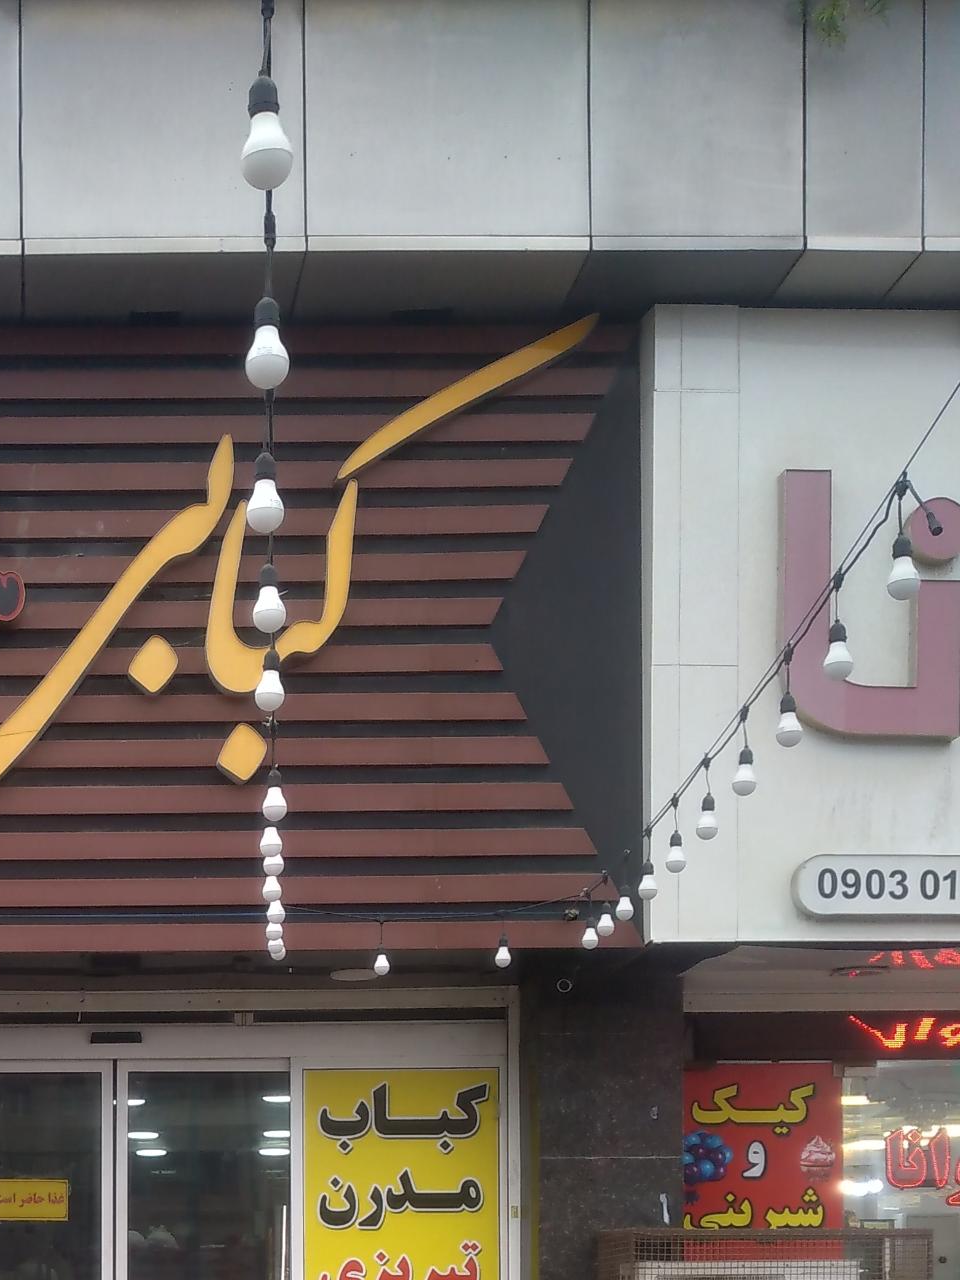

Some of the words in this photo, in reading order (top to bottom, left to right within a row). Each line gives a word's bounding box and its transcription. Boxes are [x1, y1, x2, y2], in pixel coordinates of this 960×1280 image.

[817, 867, 909, 900] 0903
[919, 869, 957, 900] 01
[318, 1082, 489, 1154] کباب
[691, 1083, 816, 1135] کیک
[742, 1141, 767, 1179] و
[317, 1167, 483, 1230] مدرن
